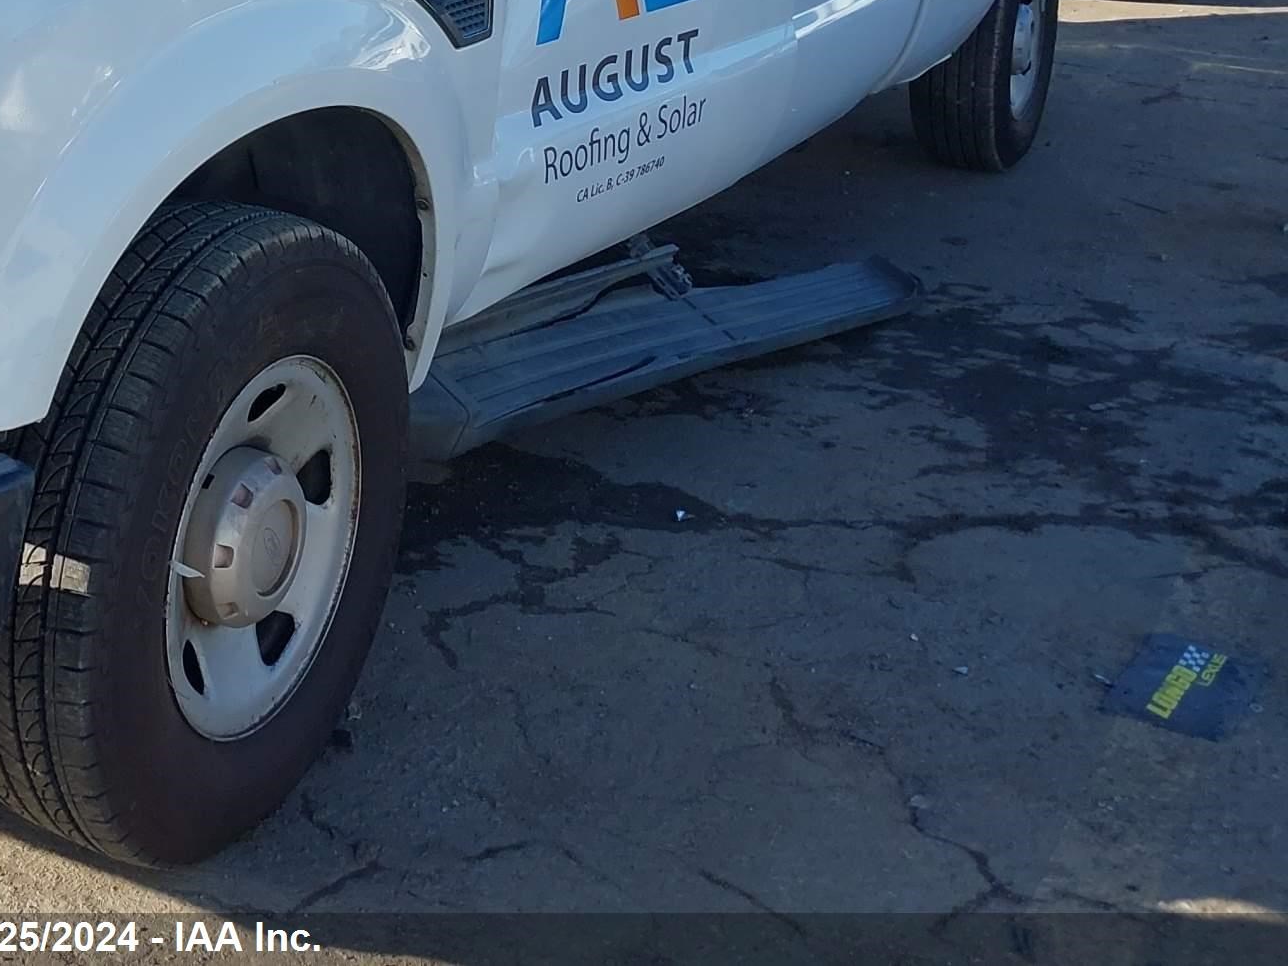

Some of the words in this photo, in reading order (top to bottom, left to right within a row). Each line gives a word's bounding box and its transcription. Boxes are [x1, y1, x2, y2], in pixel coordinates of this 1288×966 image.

[531, 28, 699, 128] AUGUST
[544, 128, 630, 184] Roofing
[637, 112, 652, 146] &
[657, 95, 706, 139] Solar
[577, 187, 588, 202] CA
